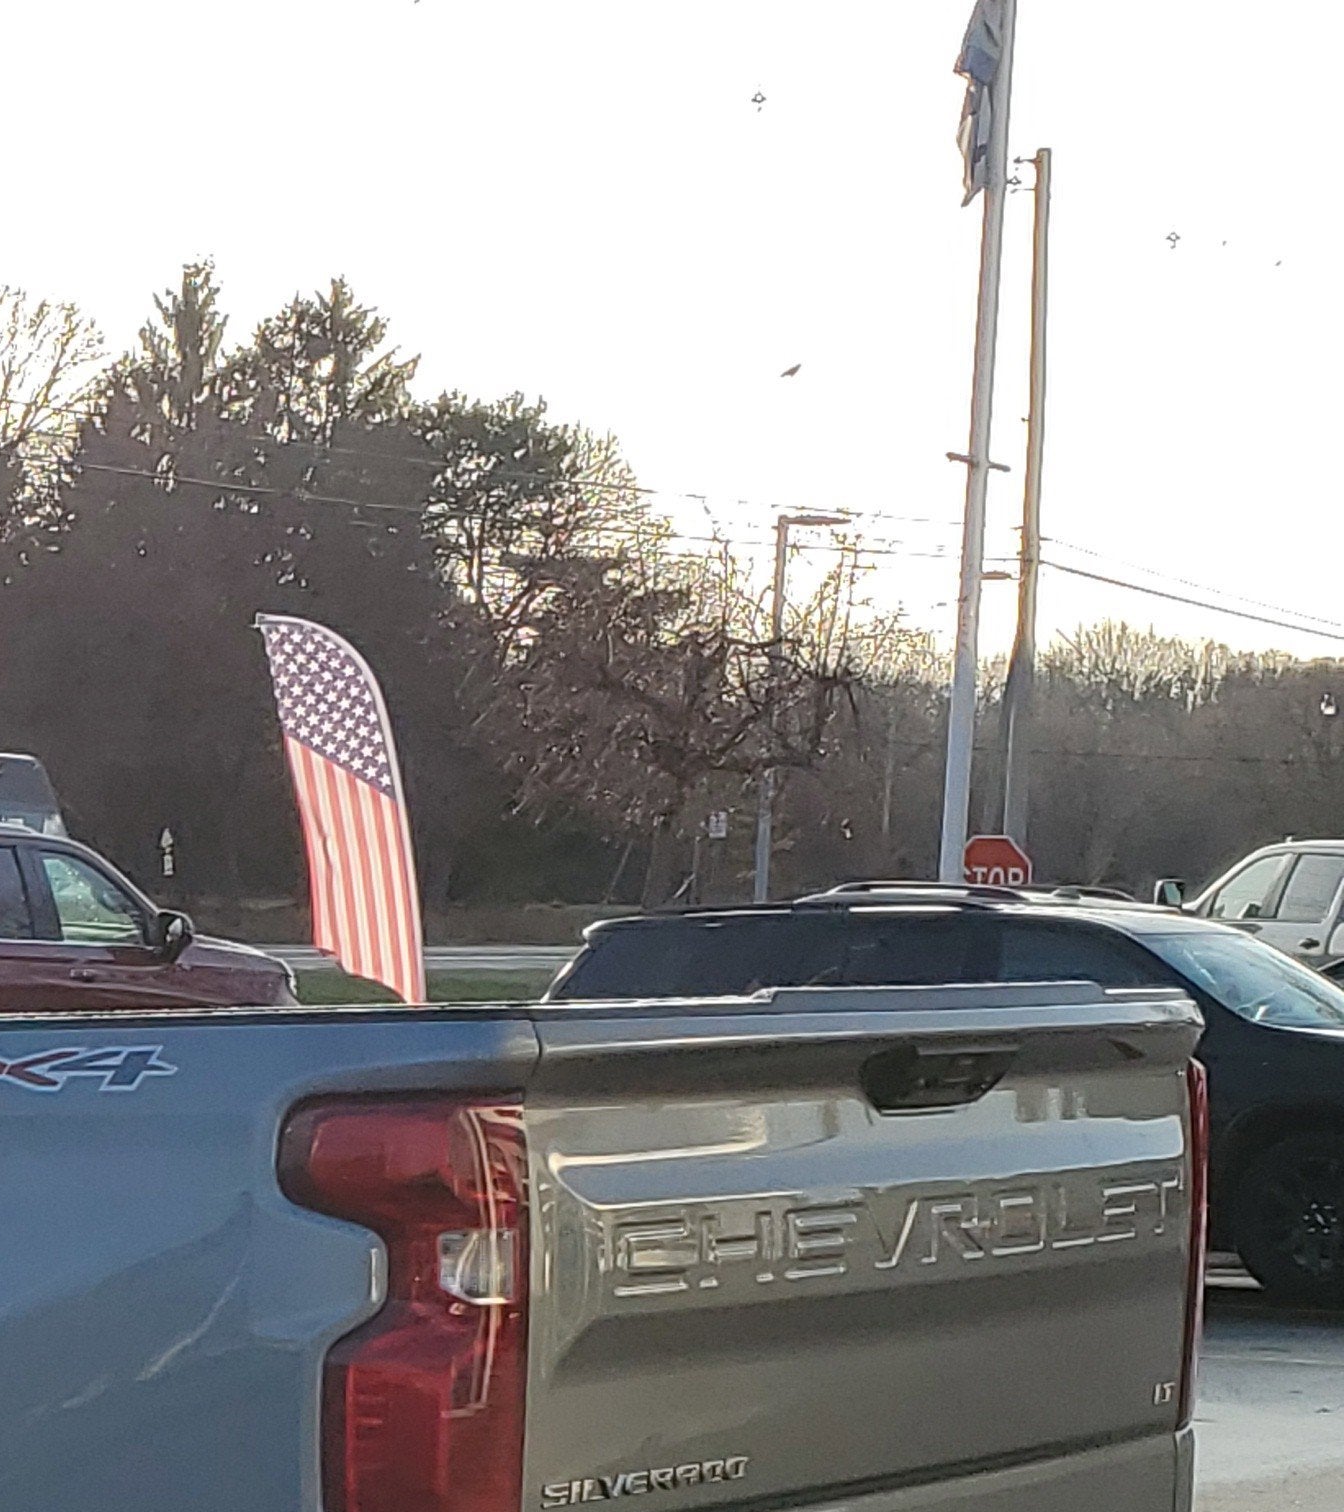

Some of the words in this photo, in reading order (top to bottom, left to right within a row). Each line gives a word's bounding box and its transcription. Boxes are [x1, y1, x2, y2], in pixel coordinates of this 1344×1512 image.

[964, 866, 1024, 886] TOP
[604, 1175, 1183, 1300] CHEVROLET
[541, 1455, 750, 1509] SILVERADO
